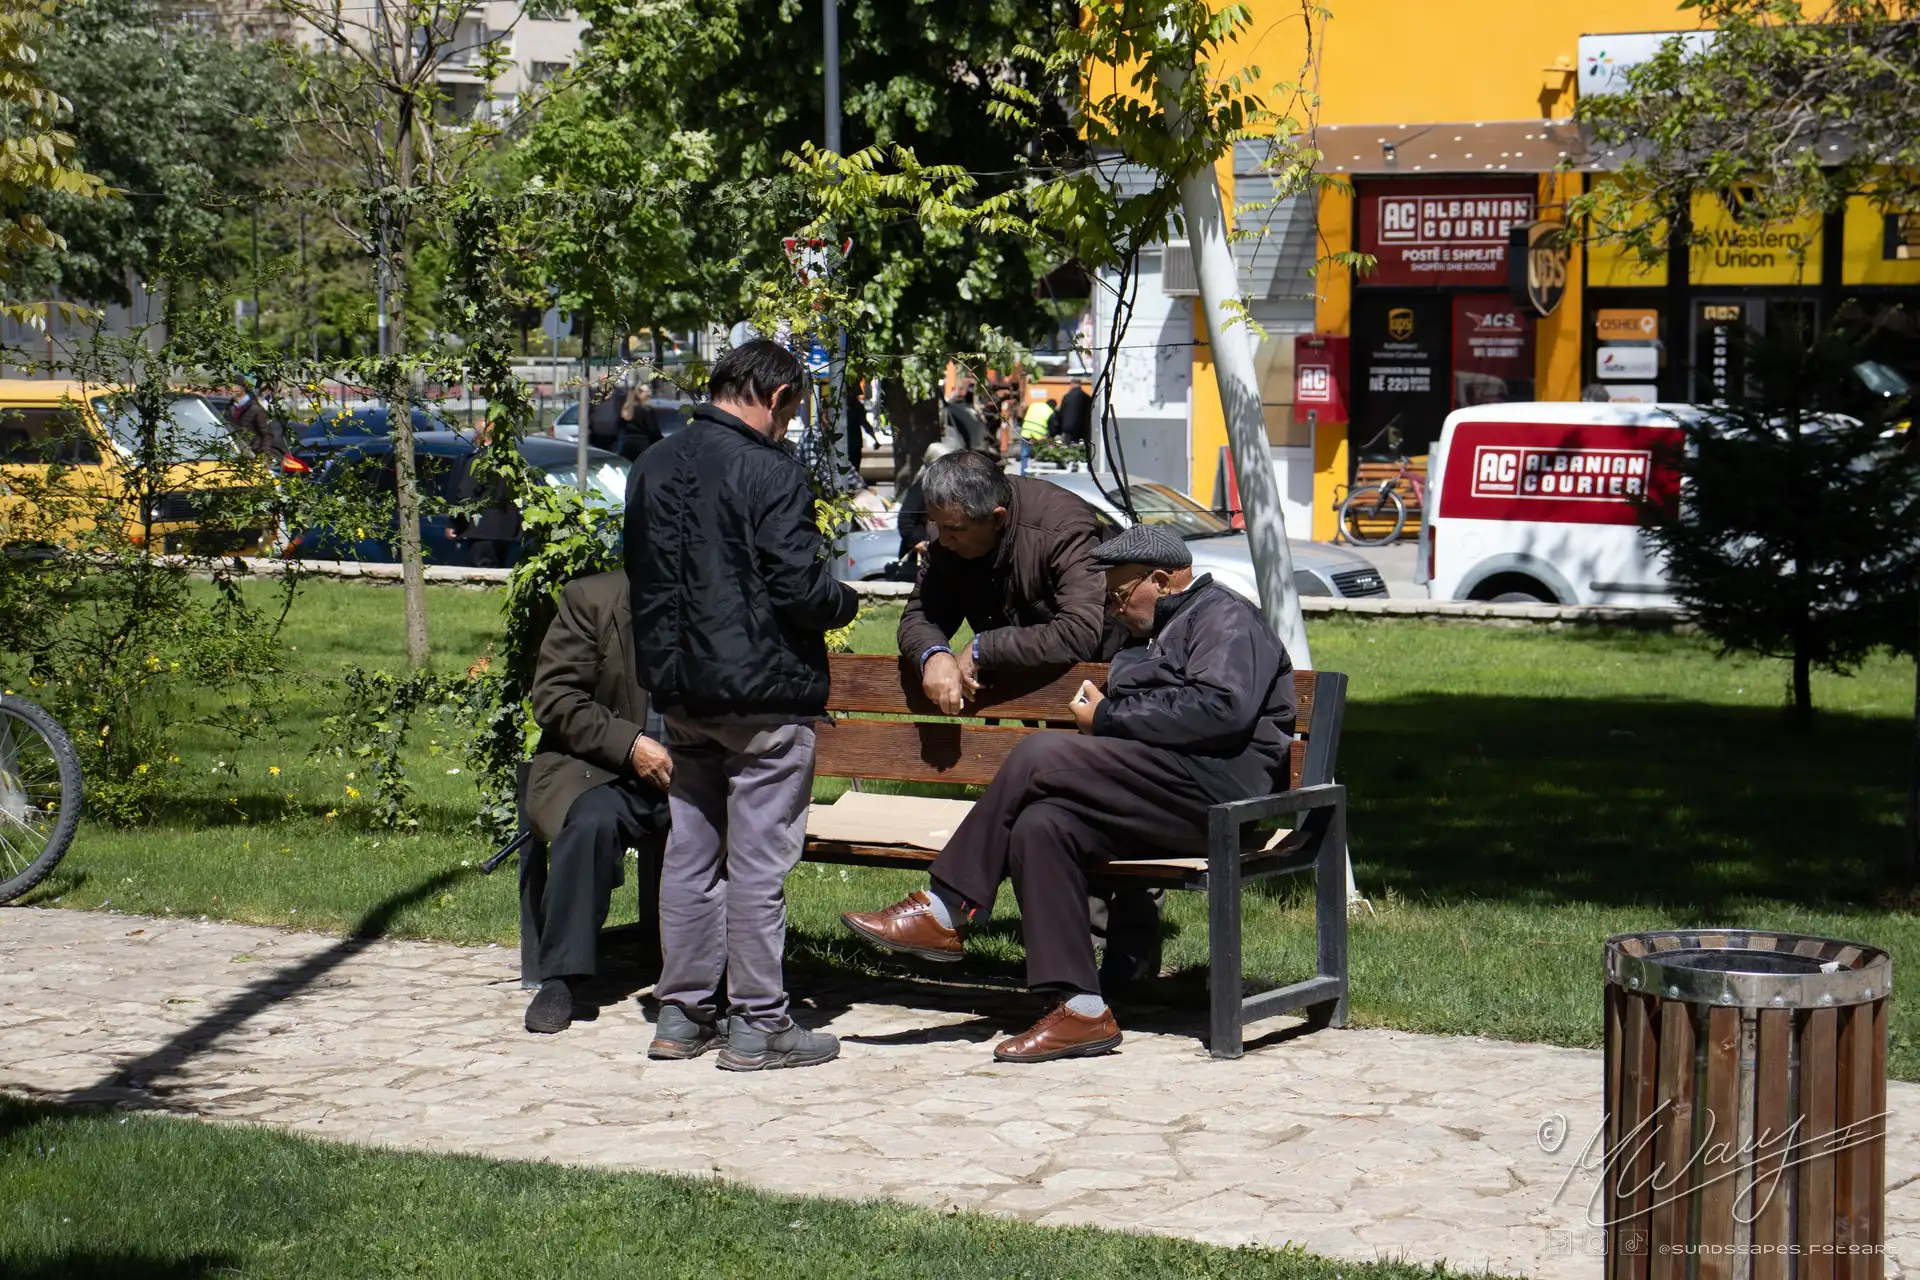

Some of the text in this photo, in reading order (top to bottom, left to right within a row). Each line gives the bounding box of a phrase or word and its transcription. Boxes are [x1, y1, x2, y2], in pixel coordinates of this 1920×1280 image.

[1384, 202, 1416, 230] AC
[1424, 200, 1528, 219] ALBANIAN
[1424, 219, 1524, 237] COURIE
[1714, 229, 1800, 248] Western
[1401, 246, 1504, 262] POSTË E SHPEJTË
[1715, 250, 1775, 268] Union
[1482, 313, 1515, 327] ACS
[1600, 318, 1641, 331] OSHEE
[1302, 369, 1326, 390] AC
[1479, 453, 1517, 482] AC
[1526, 454, 1645, 475] ALBANIAN
[1524, 474, 1641, 496] COURIER
